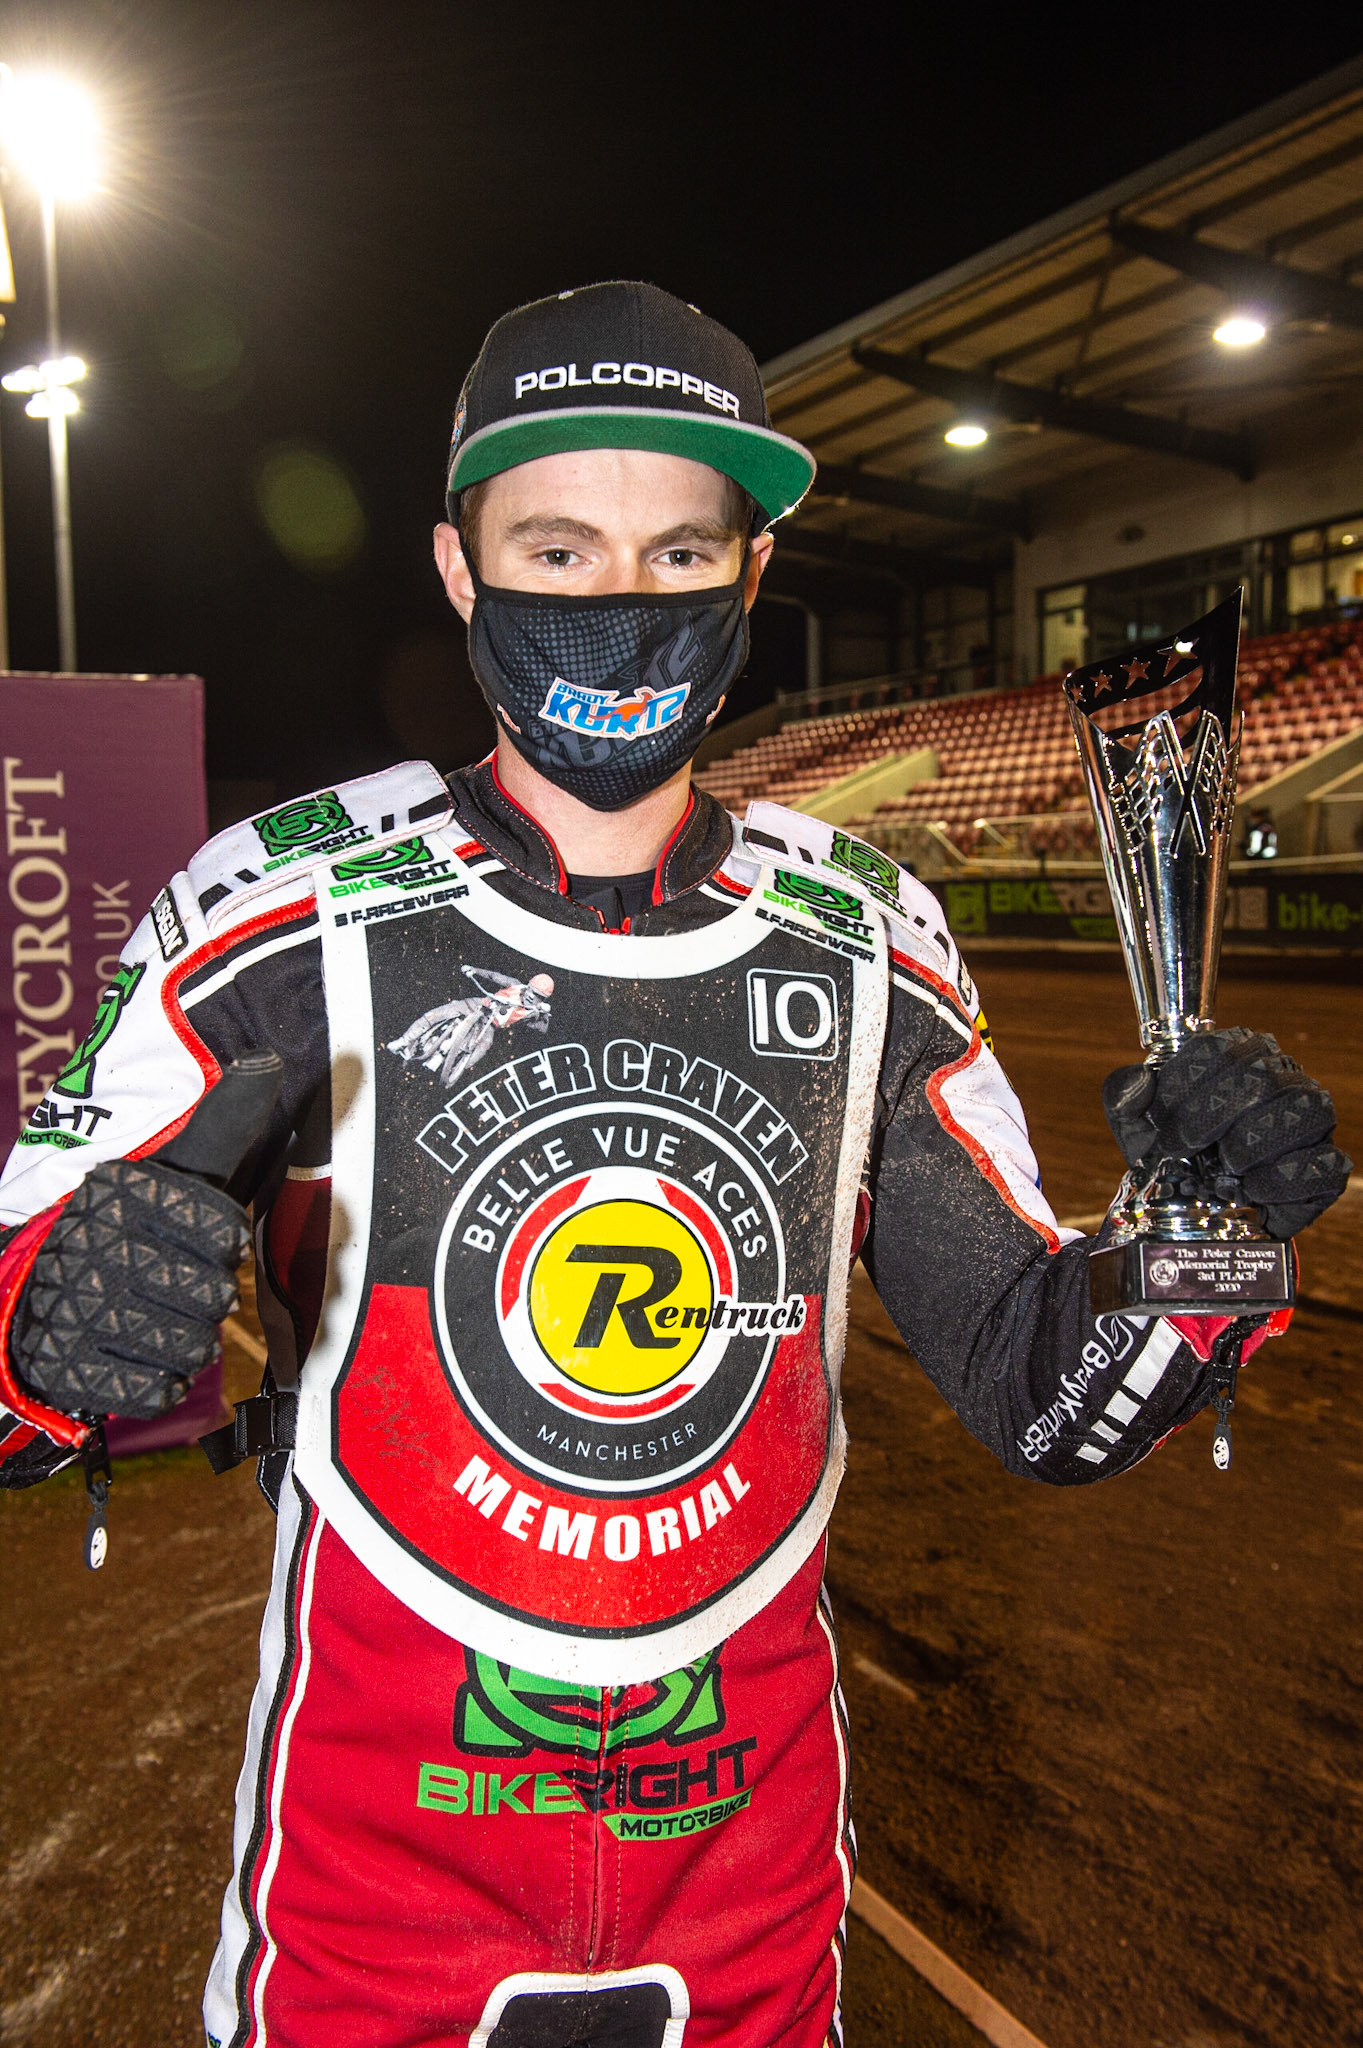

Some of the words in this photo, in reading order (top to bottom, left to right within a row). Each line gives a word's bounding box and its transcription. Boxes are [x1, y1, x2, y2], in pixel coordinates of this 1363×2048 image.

[515, 362, 740, 419] POLCOPPER
[546, 687, 687, 734] KURTZ
[556, 682, 609, 705] BRADY
[263, 825, 368, 872] BIKERIGHT
[328, 859, 451, 899] BIKERIGHT
[763, 889, 875, 938] BIKERIGHT
[3, 757, 75, 1128] EYCROFT
[753, 977, 832, 1049] 10
[415, 1043, 596, 1174] PETER
[603, 1039, 809, 1185] CRAVEN
[463, 1137, 573, 1253] BELLE
[592, 1127, 682, 1167] VUE
[692, 1161, 768, 1259] ACES
[1175, 1249, 1198, 1258] The
[1202, 1249, 1231, 1258] Peter
[1236, 1249, 1276, 1258] Craven
[1177, 1260, 1229, 1269] Memorial
[1234, 1260, 1275, 1271] Trophy
[1198, 1272, 1215, 1280] 3rd
[1220, 1272, 1256, 1280] PLACE
[565, 1244, 803, 1349] Rentruck
[537, 1423, 698, 1461] MANCHESTER
[452, 1454, 751, 1561] MEMORIAL
[417, 1736, 758, 1815] BIKERIGHT
[620, 1790, 750, 1838] MOTORBIKE
